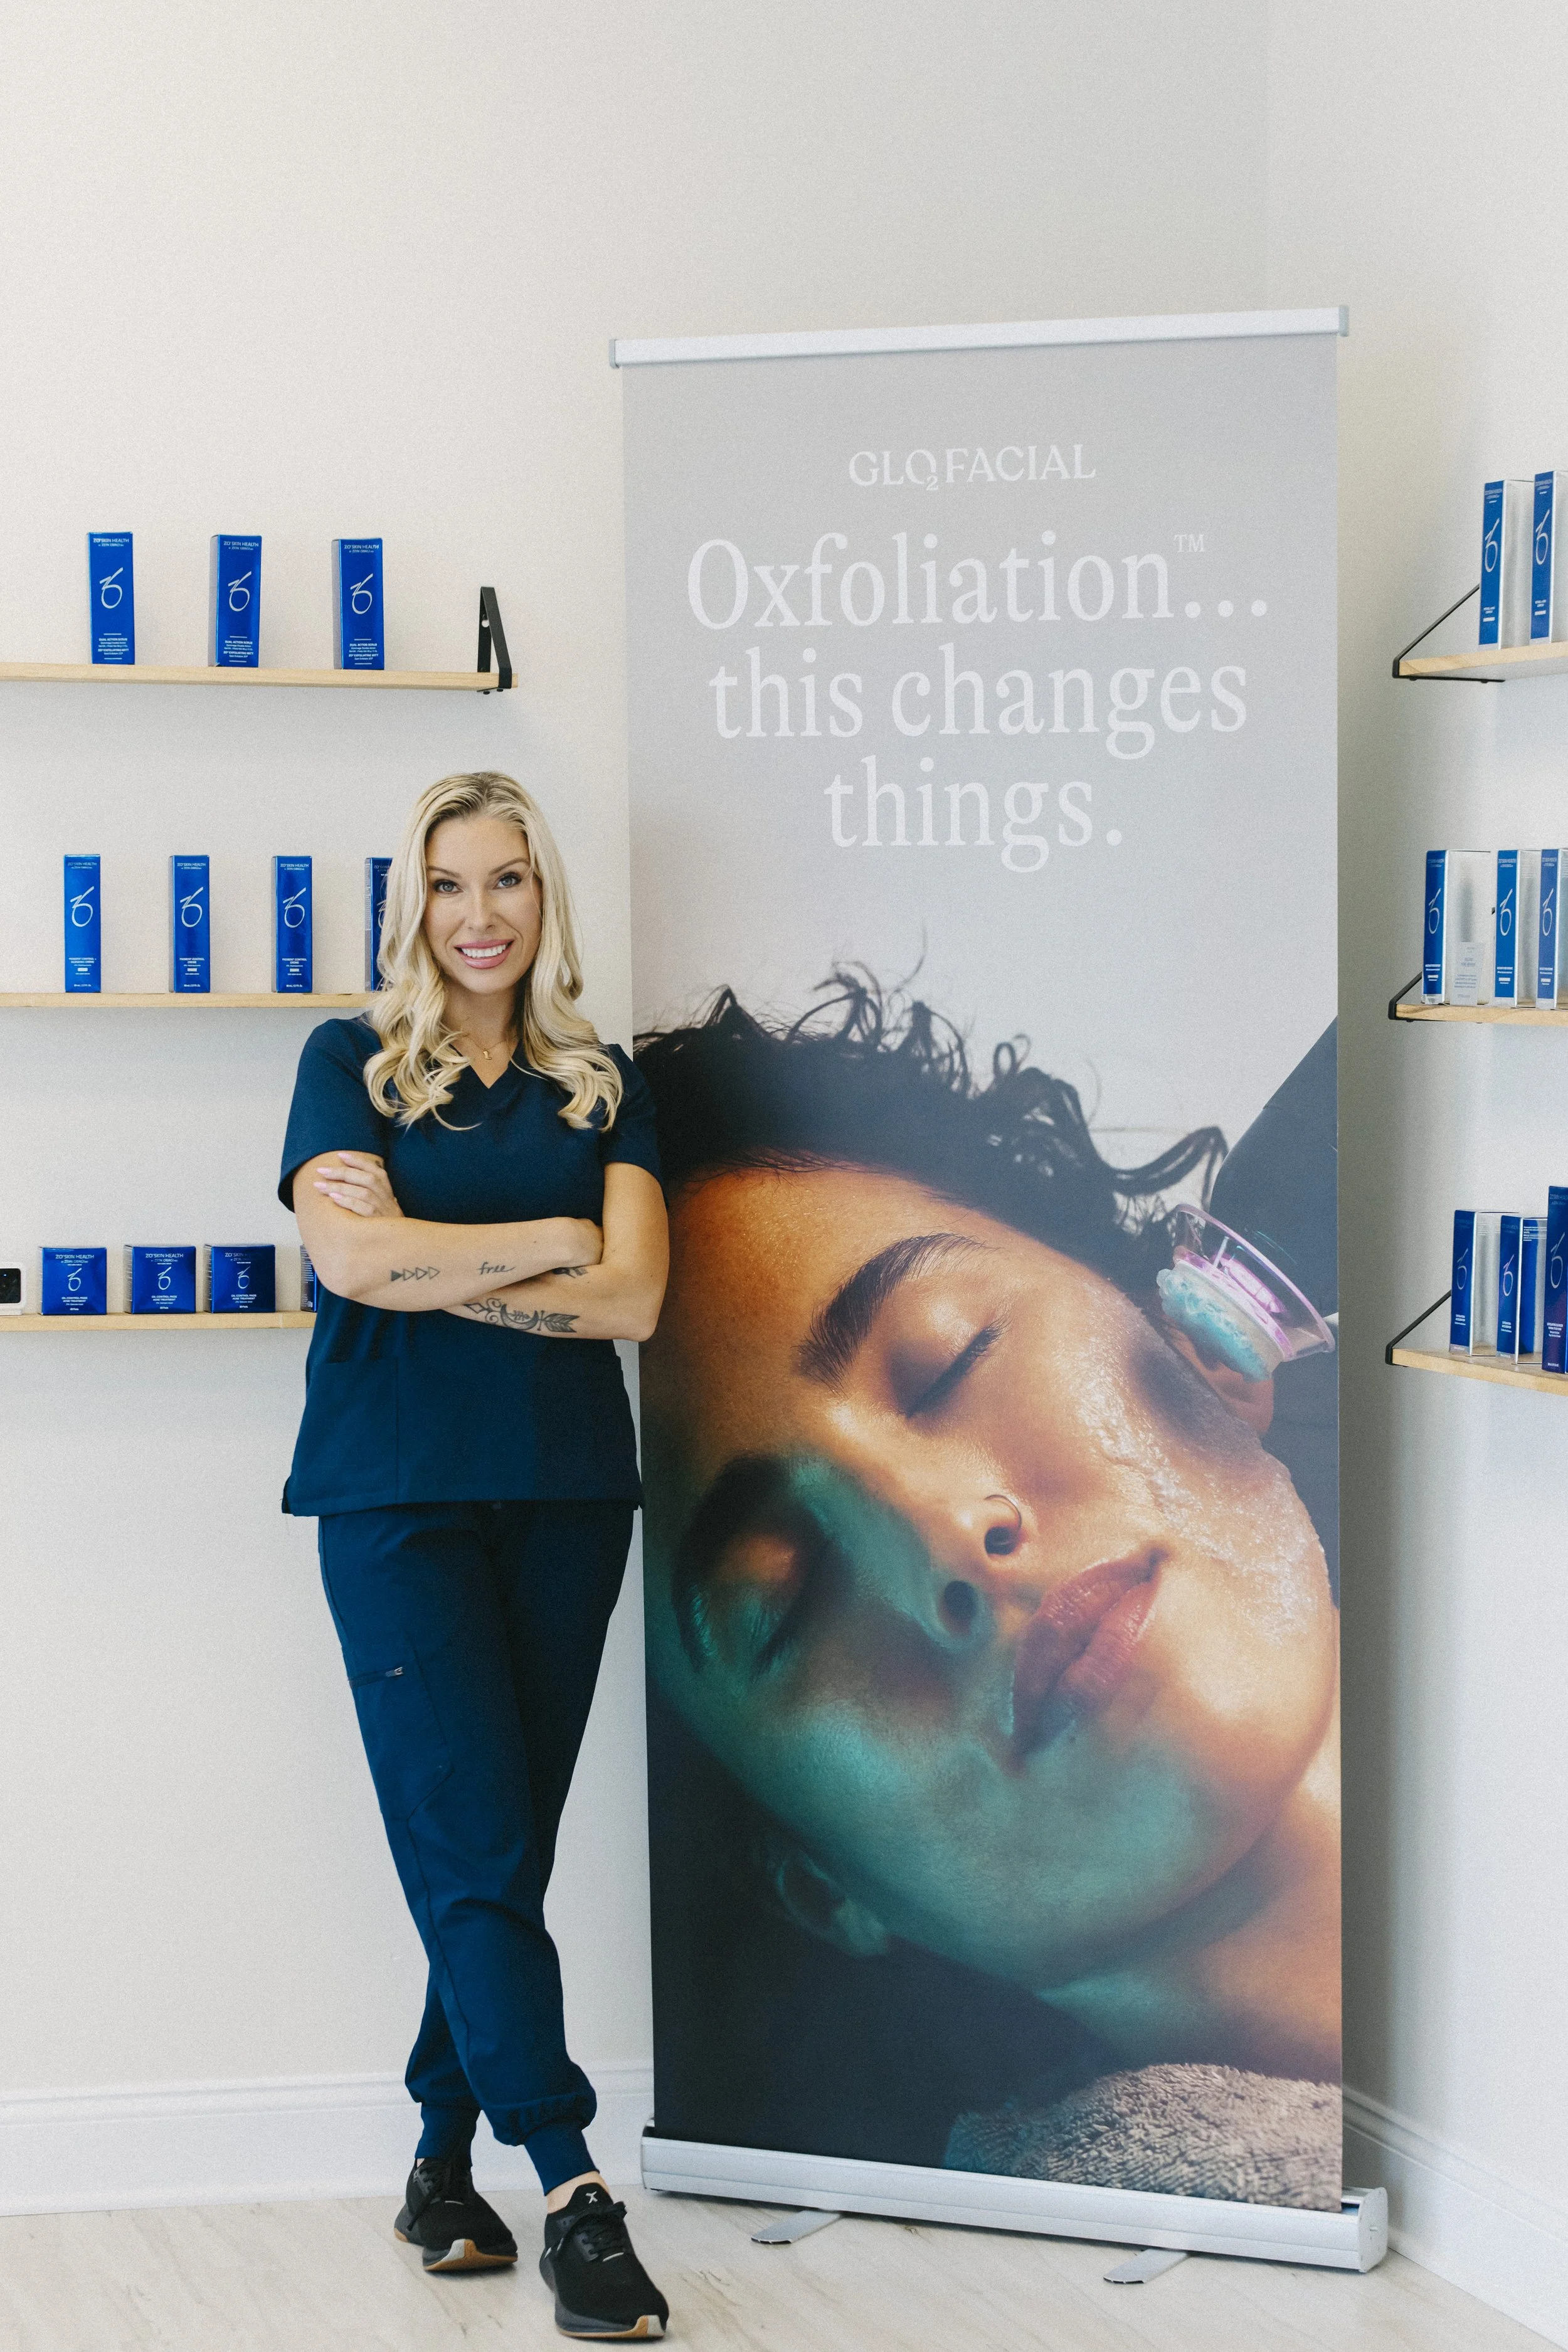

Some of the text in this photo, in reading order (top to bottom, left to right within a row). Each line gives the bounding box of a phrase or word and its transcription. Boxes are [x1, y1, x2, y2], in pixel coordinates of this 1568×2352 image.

[709, 643, 1247, 760] this changes
[824, 755, 1122, 872] things.
[477, 1261, 516, 1275] free
